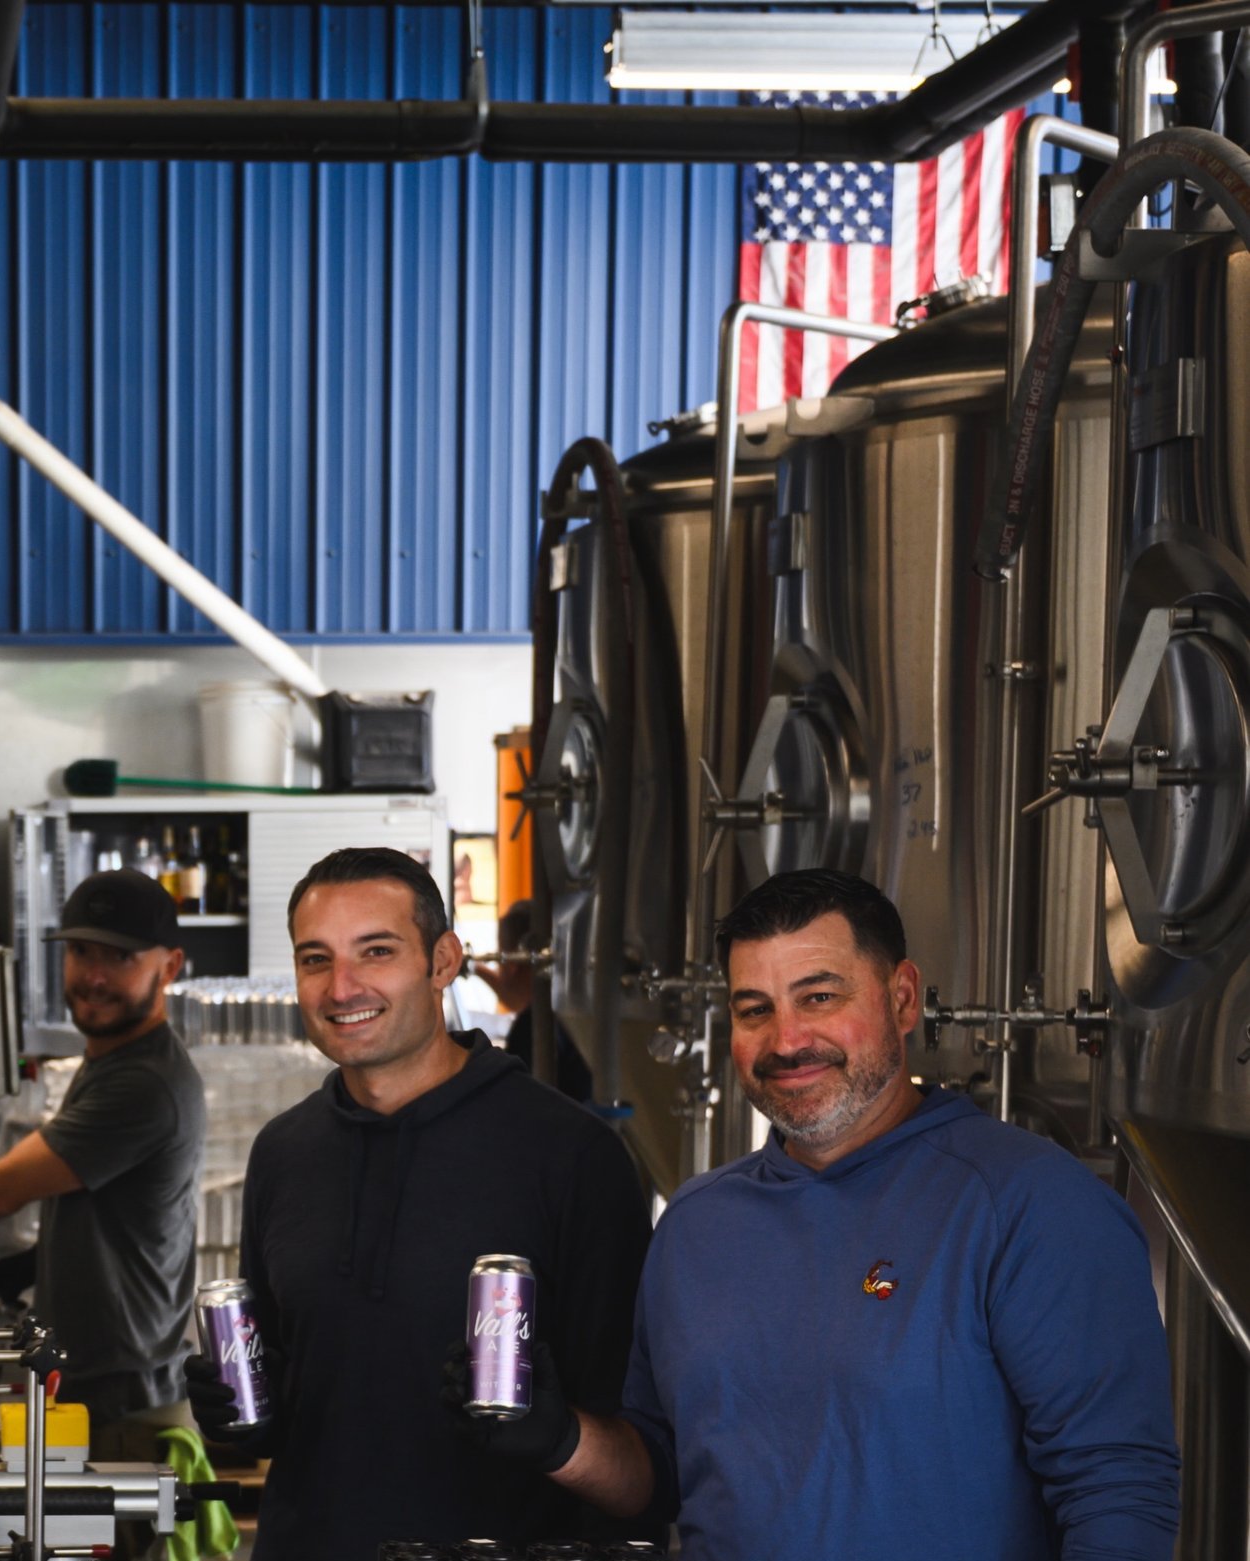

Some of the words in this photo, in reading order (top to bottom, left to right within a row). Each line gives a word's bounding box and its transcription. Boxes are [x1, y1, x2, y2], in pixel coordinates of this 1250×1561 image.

[999, 500, 1019, 556] SUCTN
[1012, 407, 1038, 485] DISCHARGE
[1028, 369, 1046, 406] HOSE
[473, 1309, 531, 1341] Val's
[485, 1339, 521, 1355] AE
